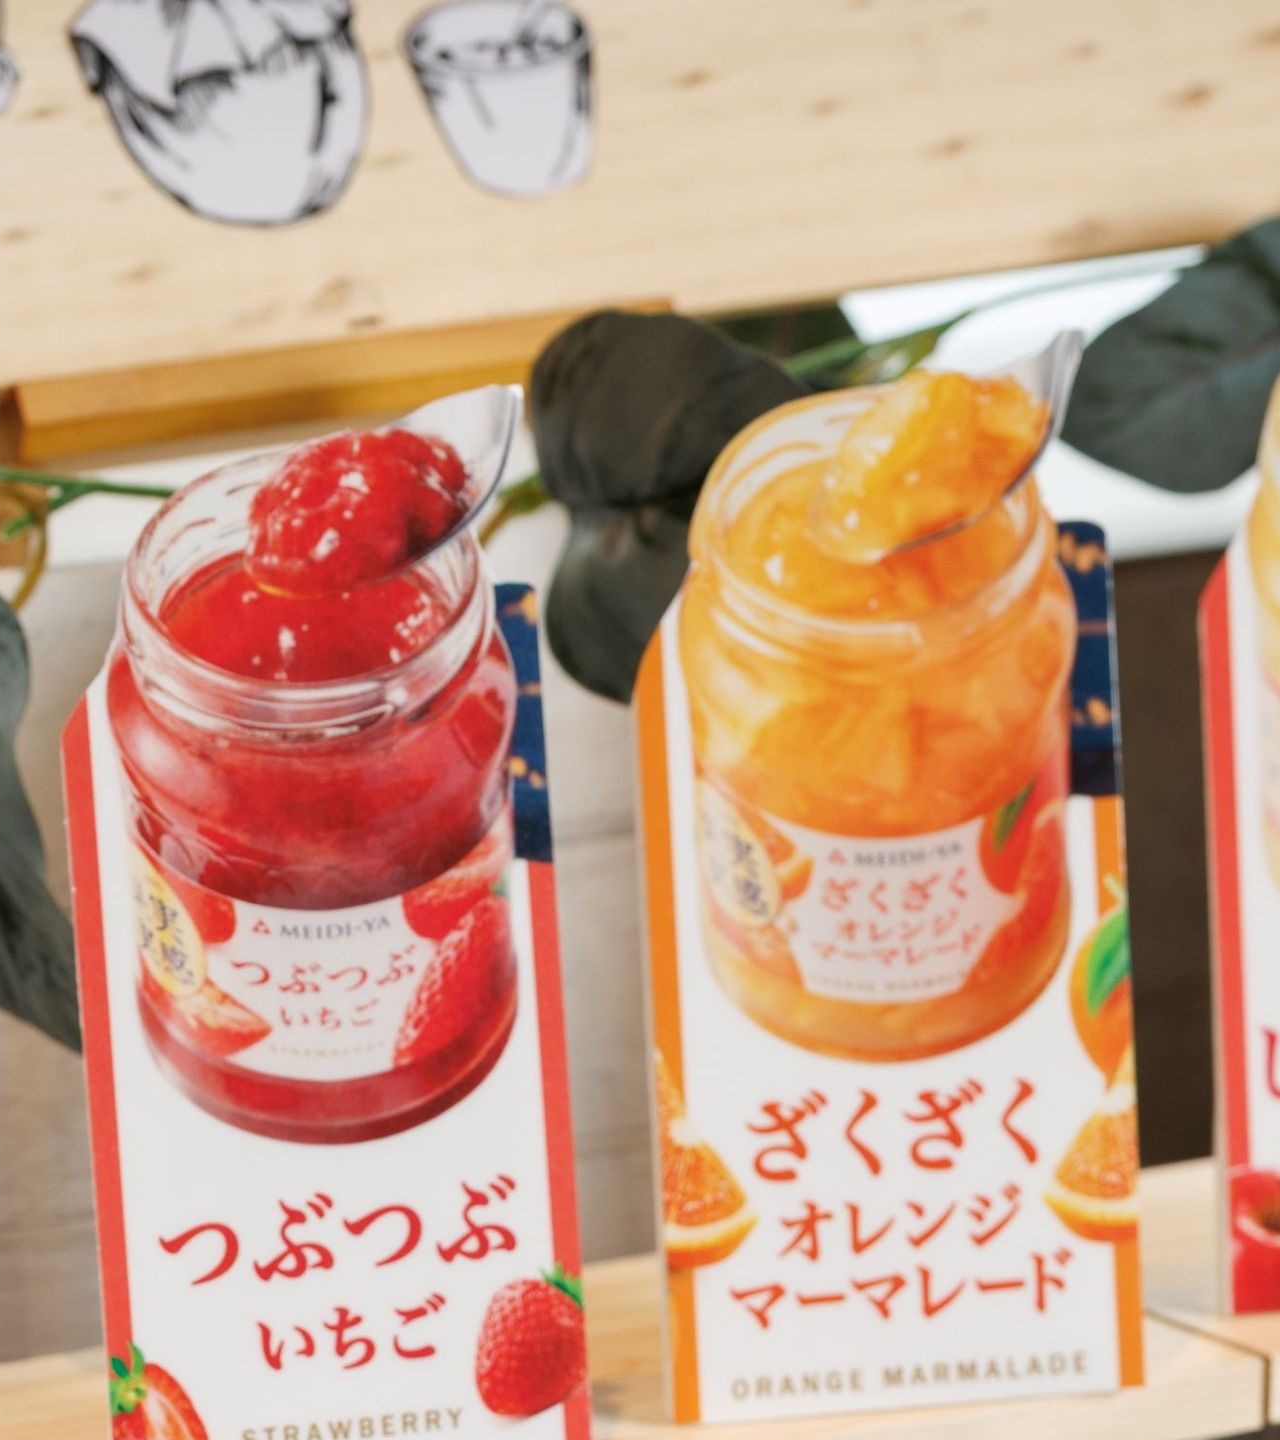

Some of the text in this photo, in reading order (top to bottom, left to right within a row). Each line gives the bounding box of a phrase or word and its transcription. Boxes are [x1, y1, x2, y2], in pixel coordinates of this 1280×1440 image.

[278, 915, 393, 942] MEIDI-YA
[229, 943, 418, 995] つぶつぶ
[279, 999, 381, 1032] いちご
[746, 1078, 1040, 1183] ざくざく
[158, 1174, 518, 1286] つぶつぶ
[778, 1183, 1024, 1262] オレンジ
[729, 1246, 1074, 1331] マーマレード
[255, 1293, 448, 1372] いちご
[730, 1350, 1089, 1402] ORANGE MARMALADE
